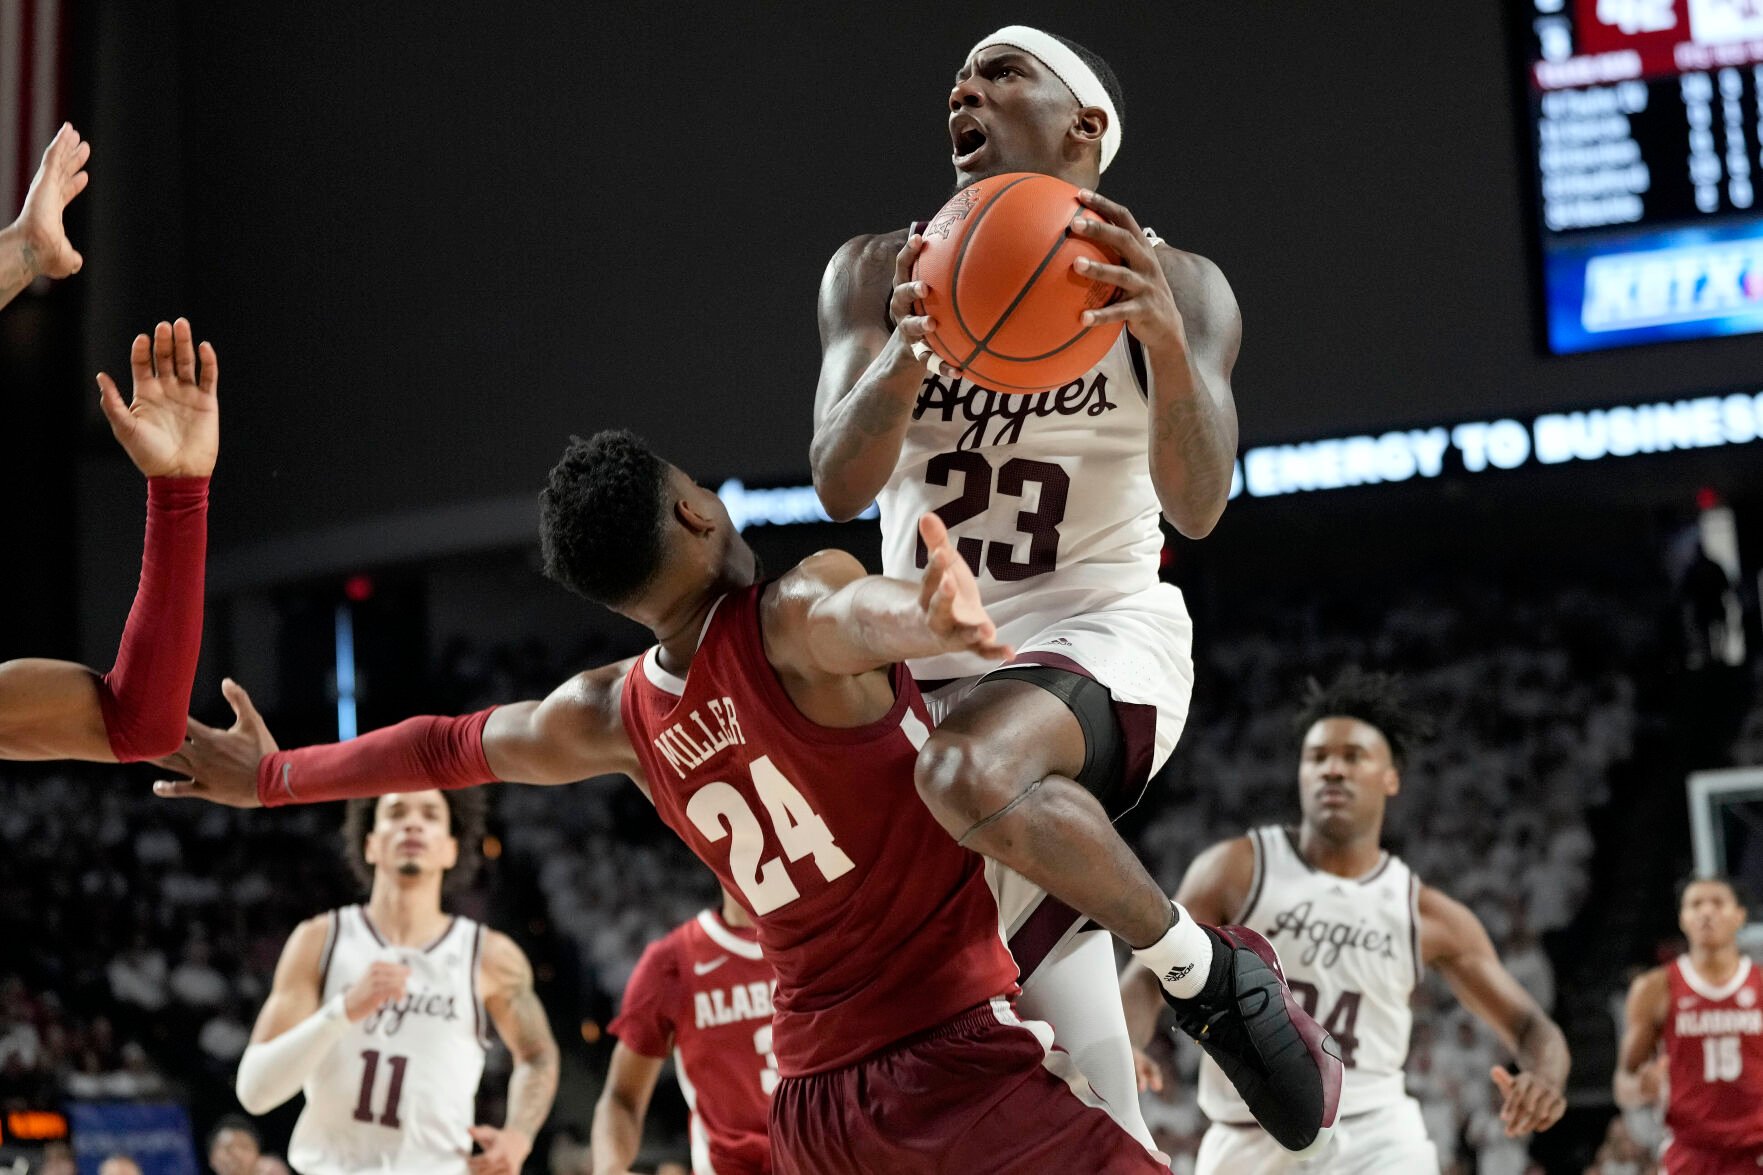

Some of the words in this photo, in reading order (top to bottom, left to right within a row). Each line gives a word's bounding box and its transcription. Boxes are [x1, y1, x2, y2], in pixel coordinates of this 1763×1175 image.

[911, 371, 1118, 451] Aggies
[1244, 425, 1450, 498] ENERGY
[1451, 418, 1532, 473] TO
[915, 451, 1076, 582] 23
[653, 696, 746, 780] MILLER
[685, 754, 856, 917] 24
[1265, 901, 1397, 969] Aggies
[694, 978, 778, 1030] ALAB
[353, 1049, 408, 1129] 11
[1702, 1036, 1743, 1083] 15
